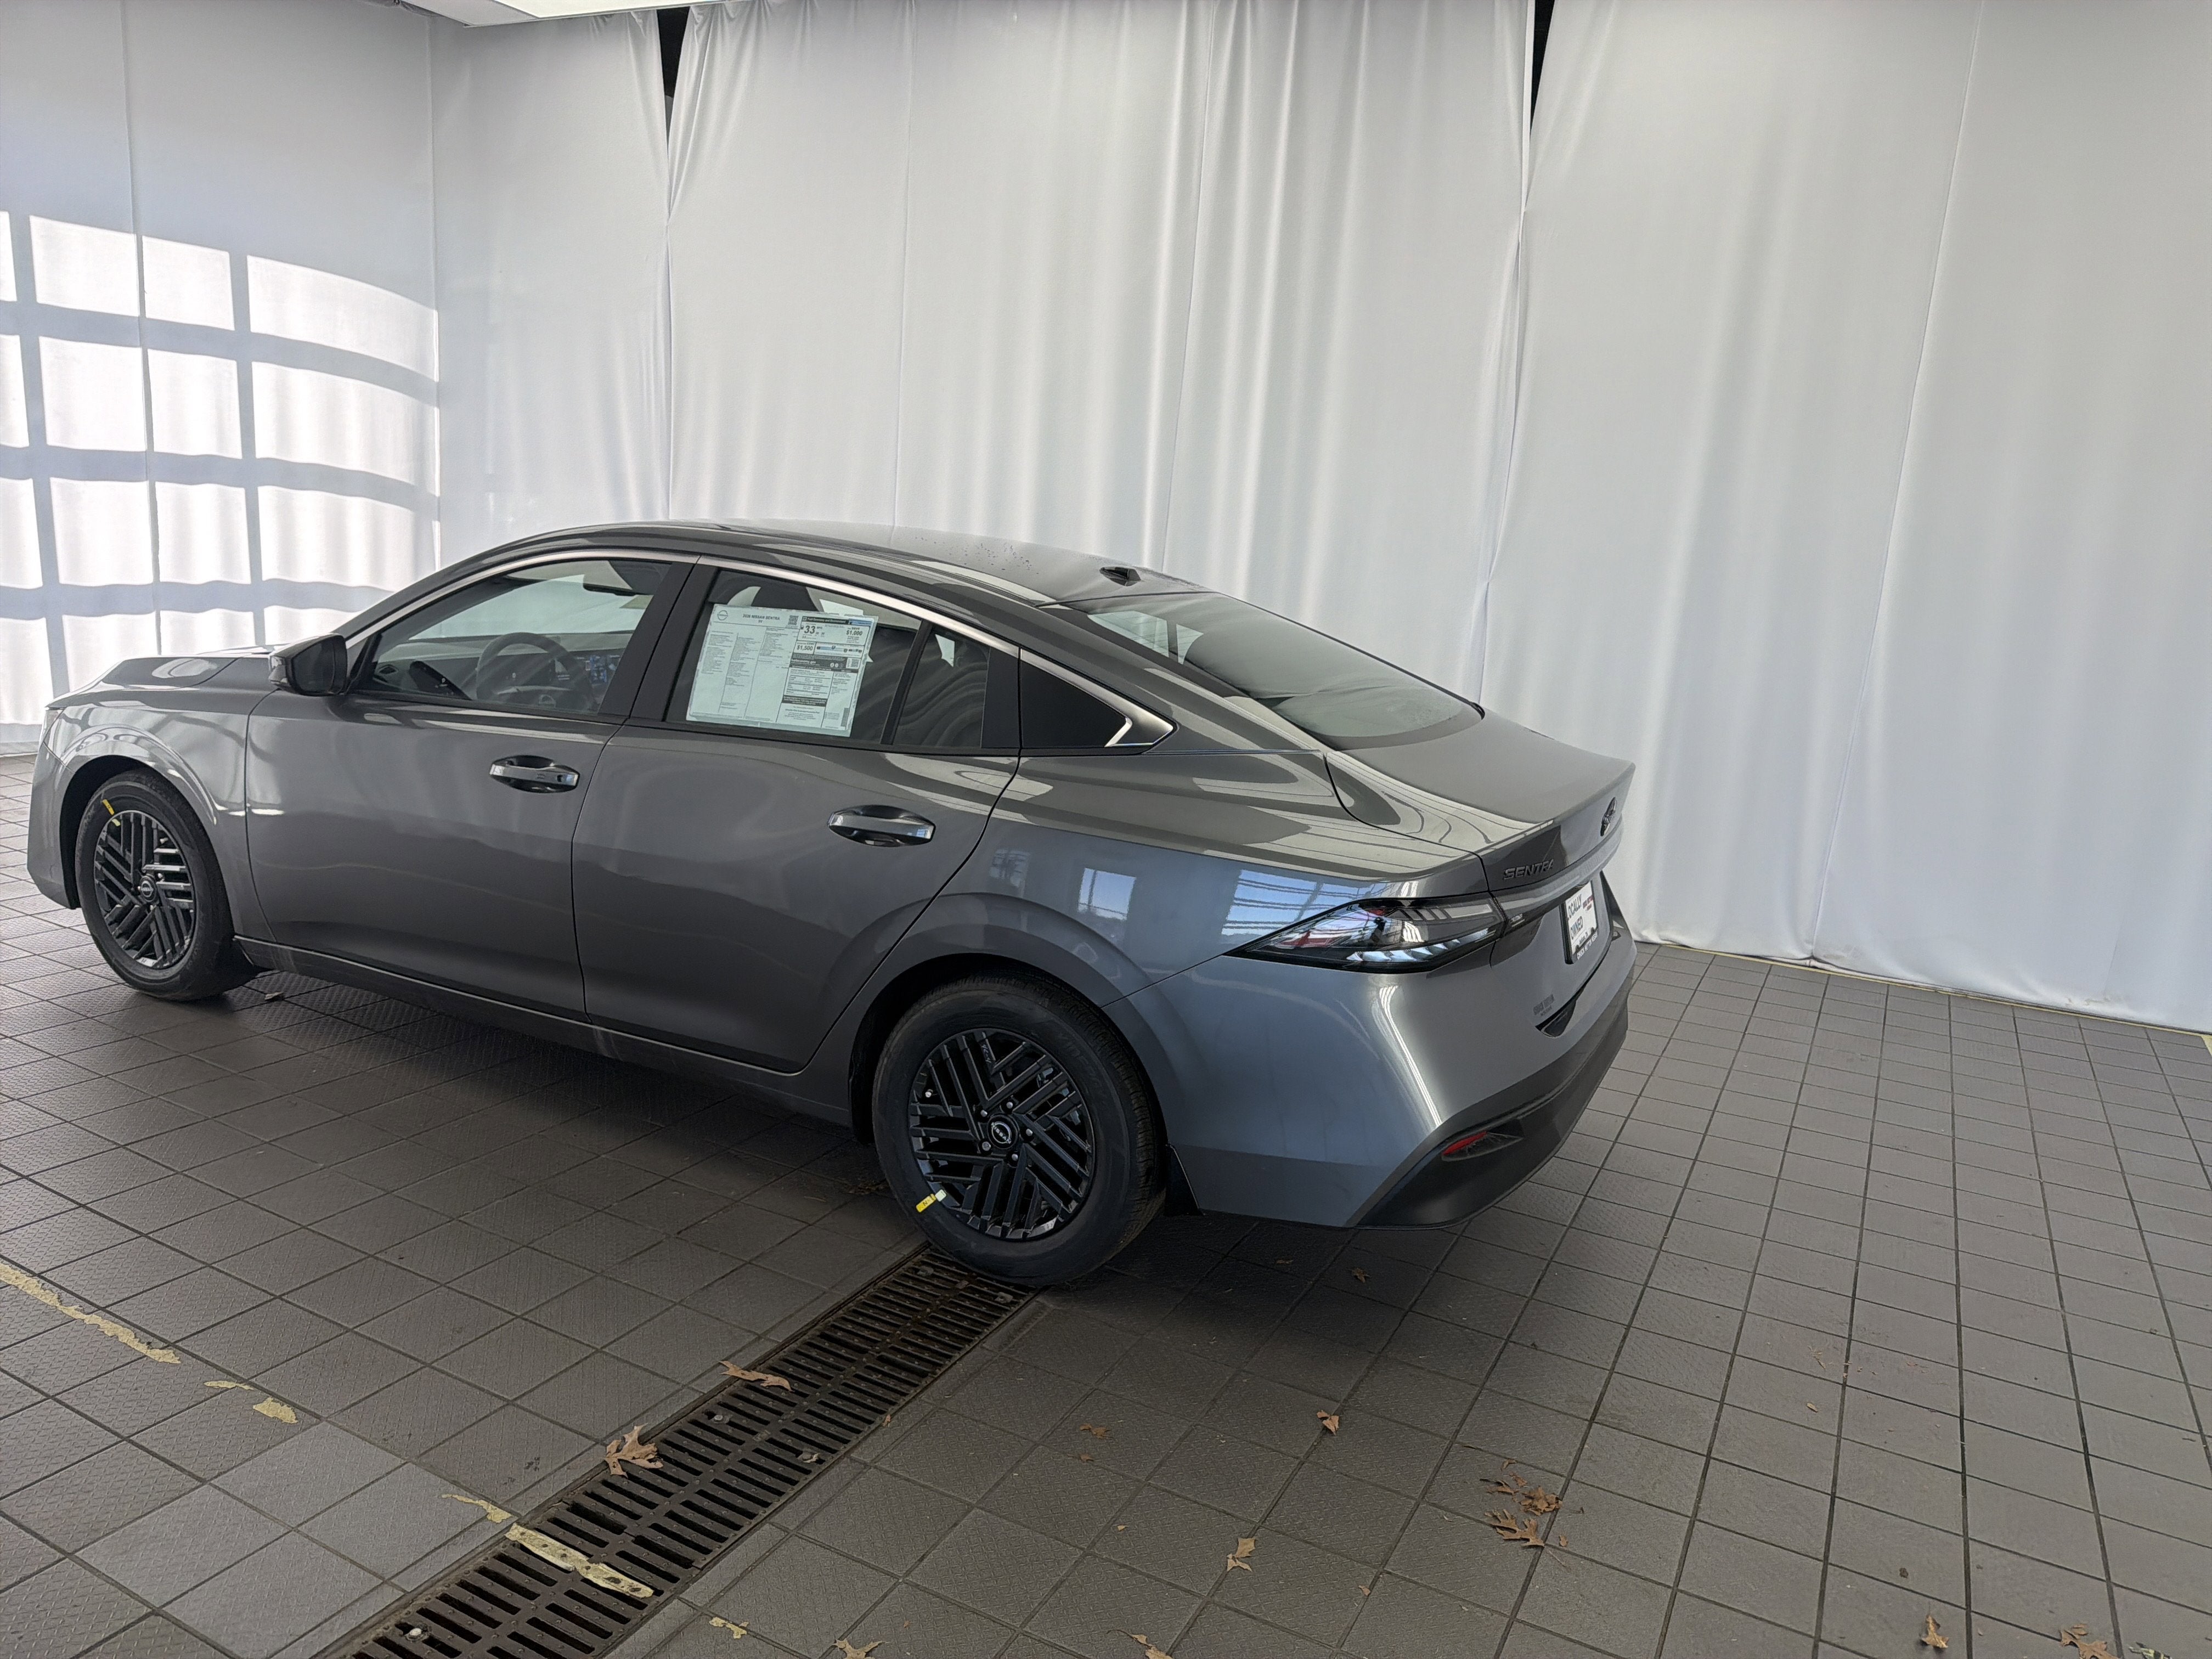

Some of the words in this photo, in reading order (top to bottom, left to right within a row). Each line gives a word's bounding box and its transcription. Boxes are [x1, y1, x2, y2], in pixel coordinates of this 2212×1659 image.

[804, 625, 816, 634] 33
[1503, 859, 1554, 881] SENTRA
[1567, 893, 1582, 921] OCALLY
[1570, 915, 1583, 940] OWNED
